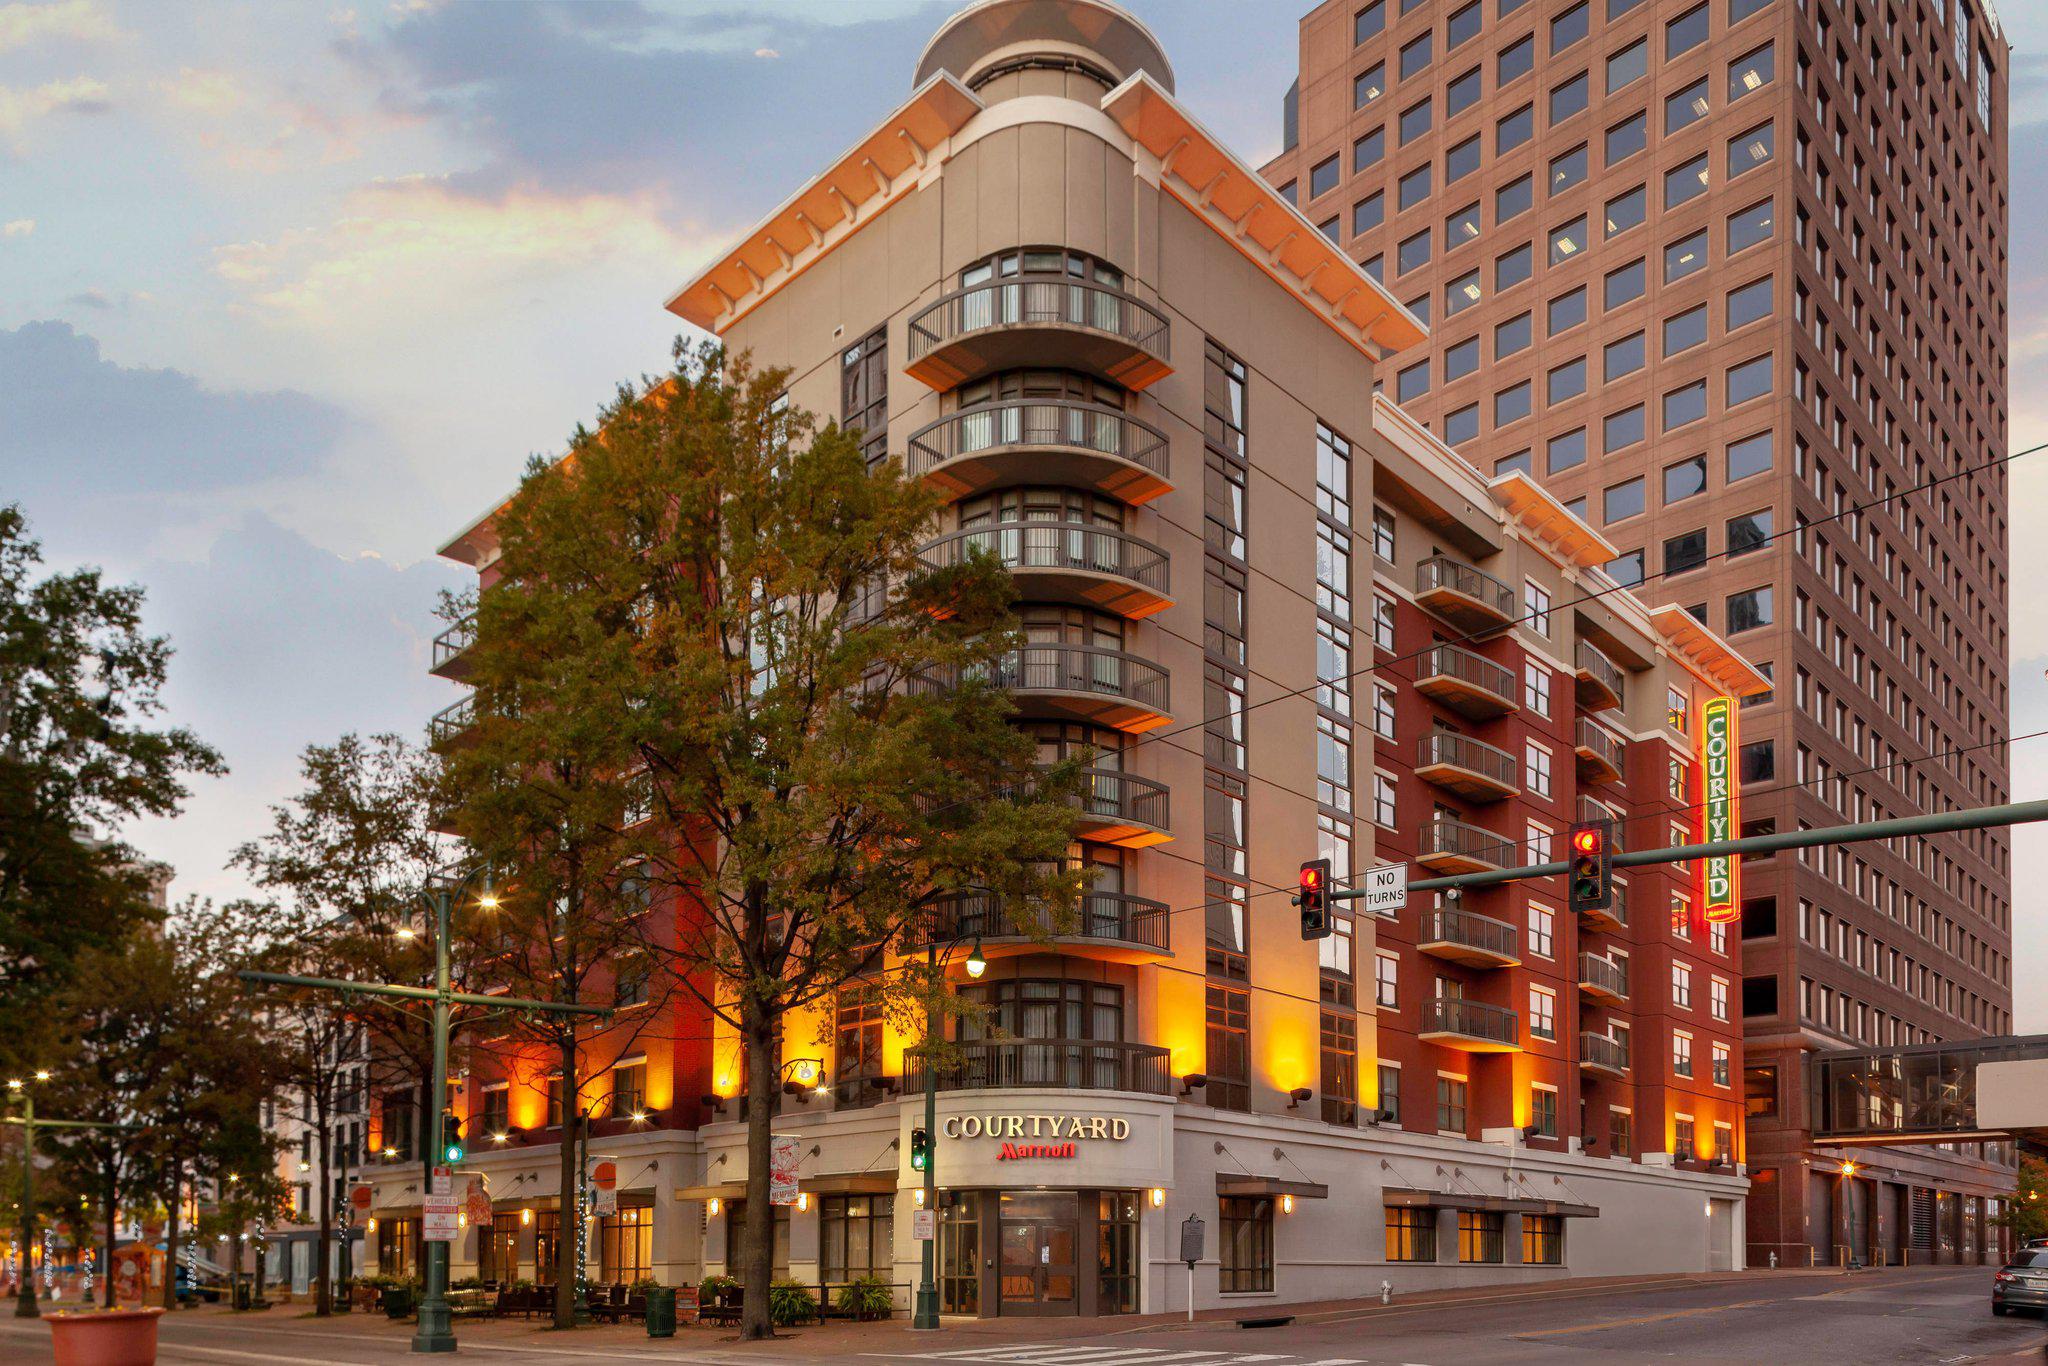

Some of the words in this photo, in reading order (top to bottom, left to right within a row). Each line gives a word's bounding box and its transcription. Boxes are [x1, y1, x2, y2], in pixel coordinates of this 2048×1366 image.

[1708, 717, 1728, 897] COURTYRD
[1377, 872, 1395, 886] NO
[1368, 889, 1404, 904] TURNS
[943, 1115, 1130, 1140] COURTYARD
[996, 1142, 1075, 1160] Marriott
